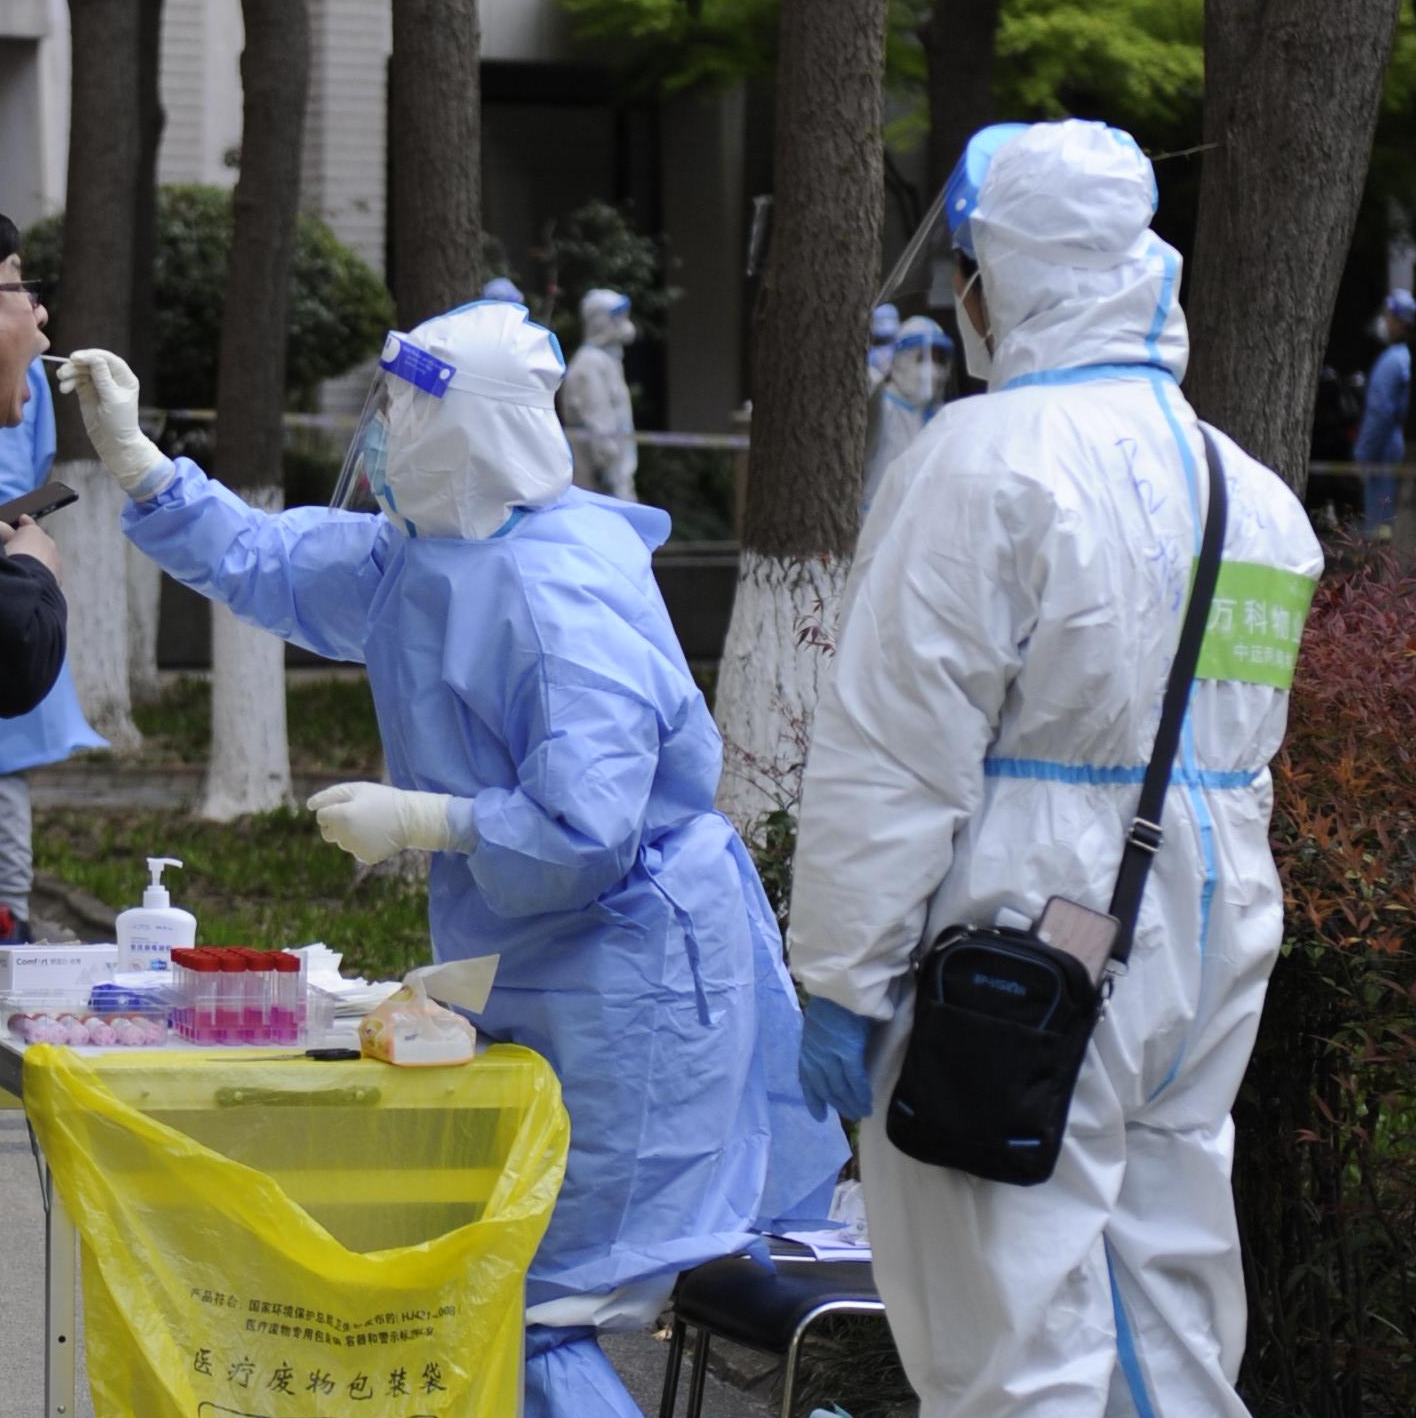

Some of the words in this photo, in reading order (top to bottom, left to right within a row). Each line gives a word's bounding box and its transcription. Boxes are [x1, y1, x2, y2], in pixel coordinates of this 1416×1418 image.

[193, 1347, 447, 1401] 医疗废物包装袋
